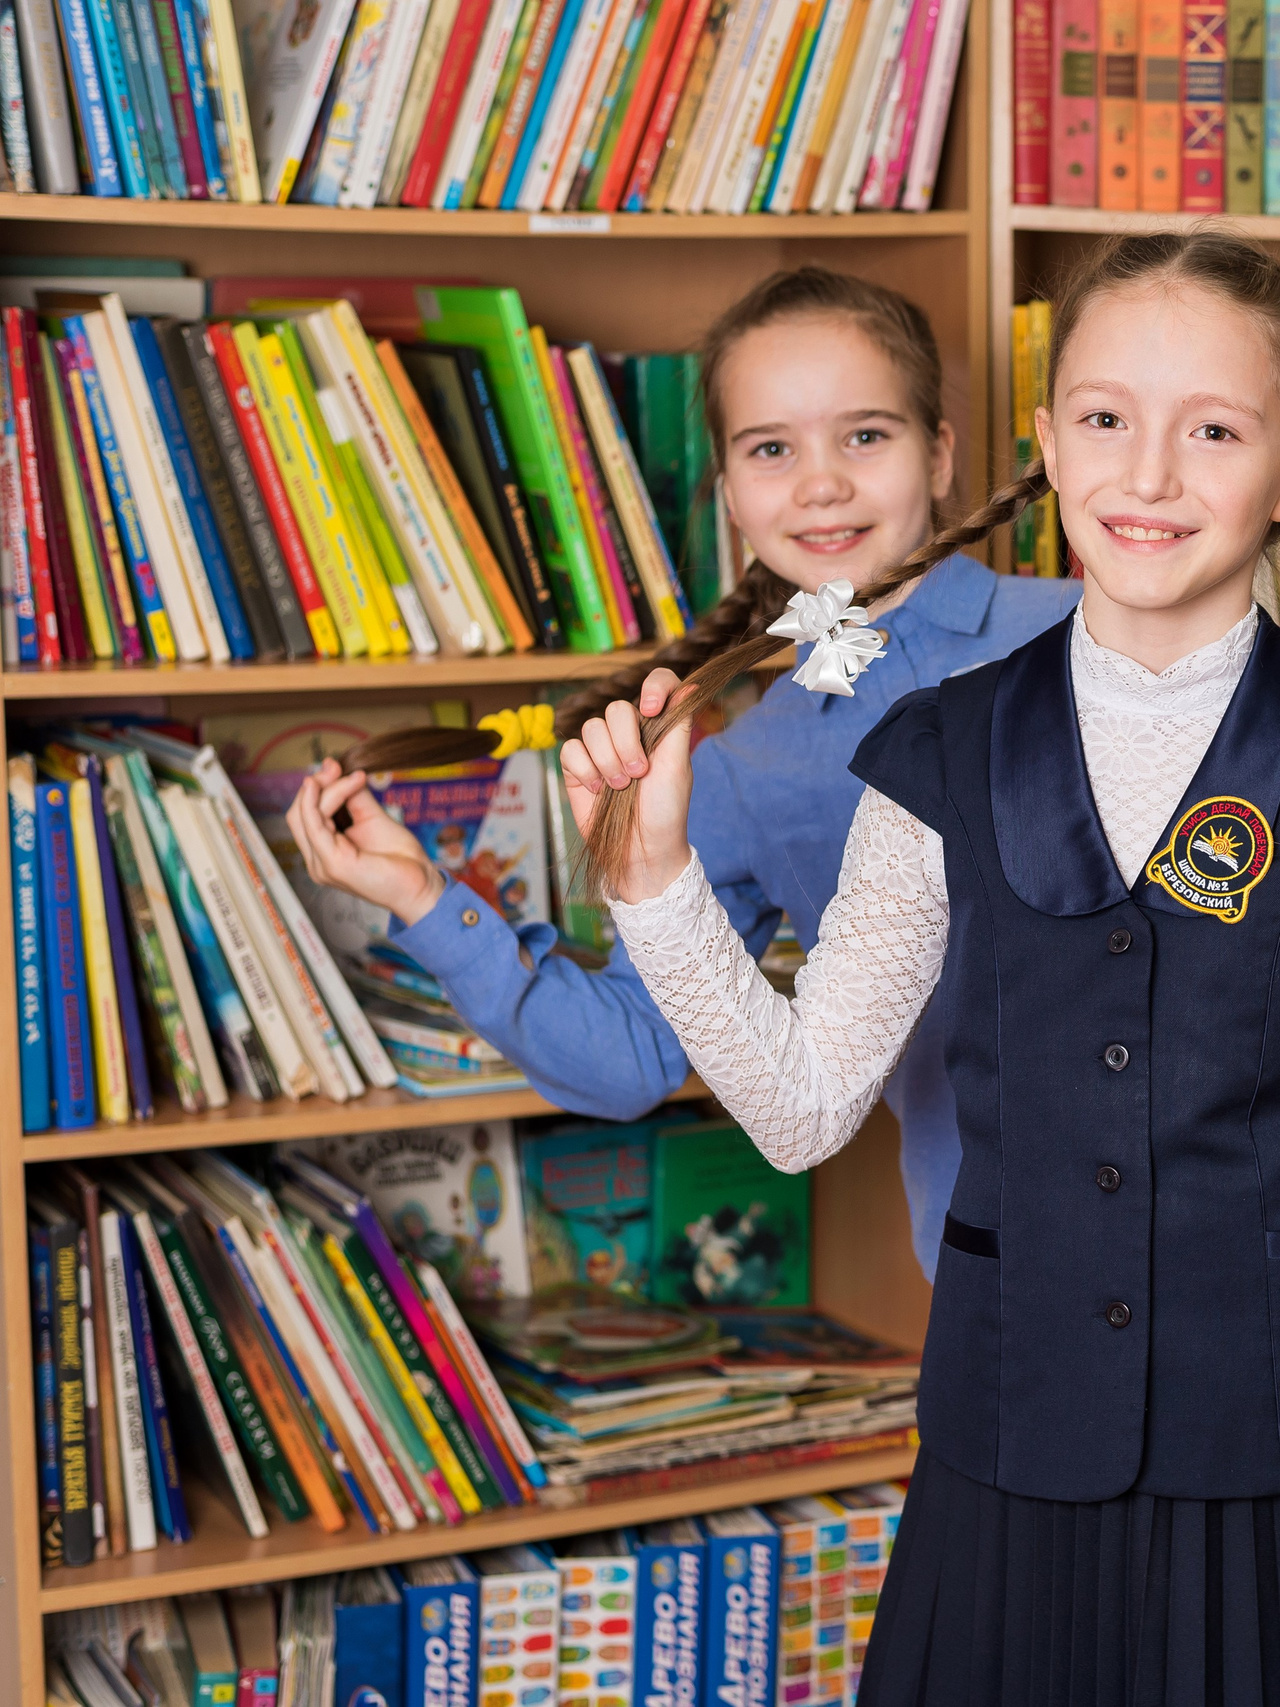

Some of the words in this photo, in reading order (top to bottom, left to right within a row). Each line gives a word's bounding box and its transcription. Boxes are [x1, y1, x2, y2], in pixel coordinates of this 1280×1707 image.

[1179, 810, 1208, 838] УЧИСЬ
[1211, 802, 1252, 819] ДЕРЗАЙ
[49, 830, 71, 903] СКАЗОК
[1161, 863, 1233, 909] БЕРЕЗОВСКИЙ
[1178, 858, 1207, 890] ШКОЛА
[363, 1271, 424, 1362] СКАЗКИ
[222, 1369, 279, 1460] СКАЗКИ
[713, 1585, 748, 1707] ДРЕВО
